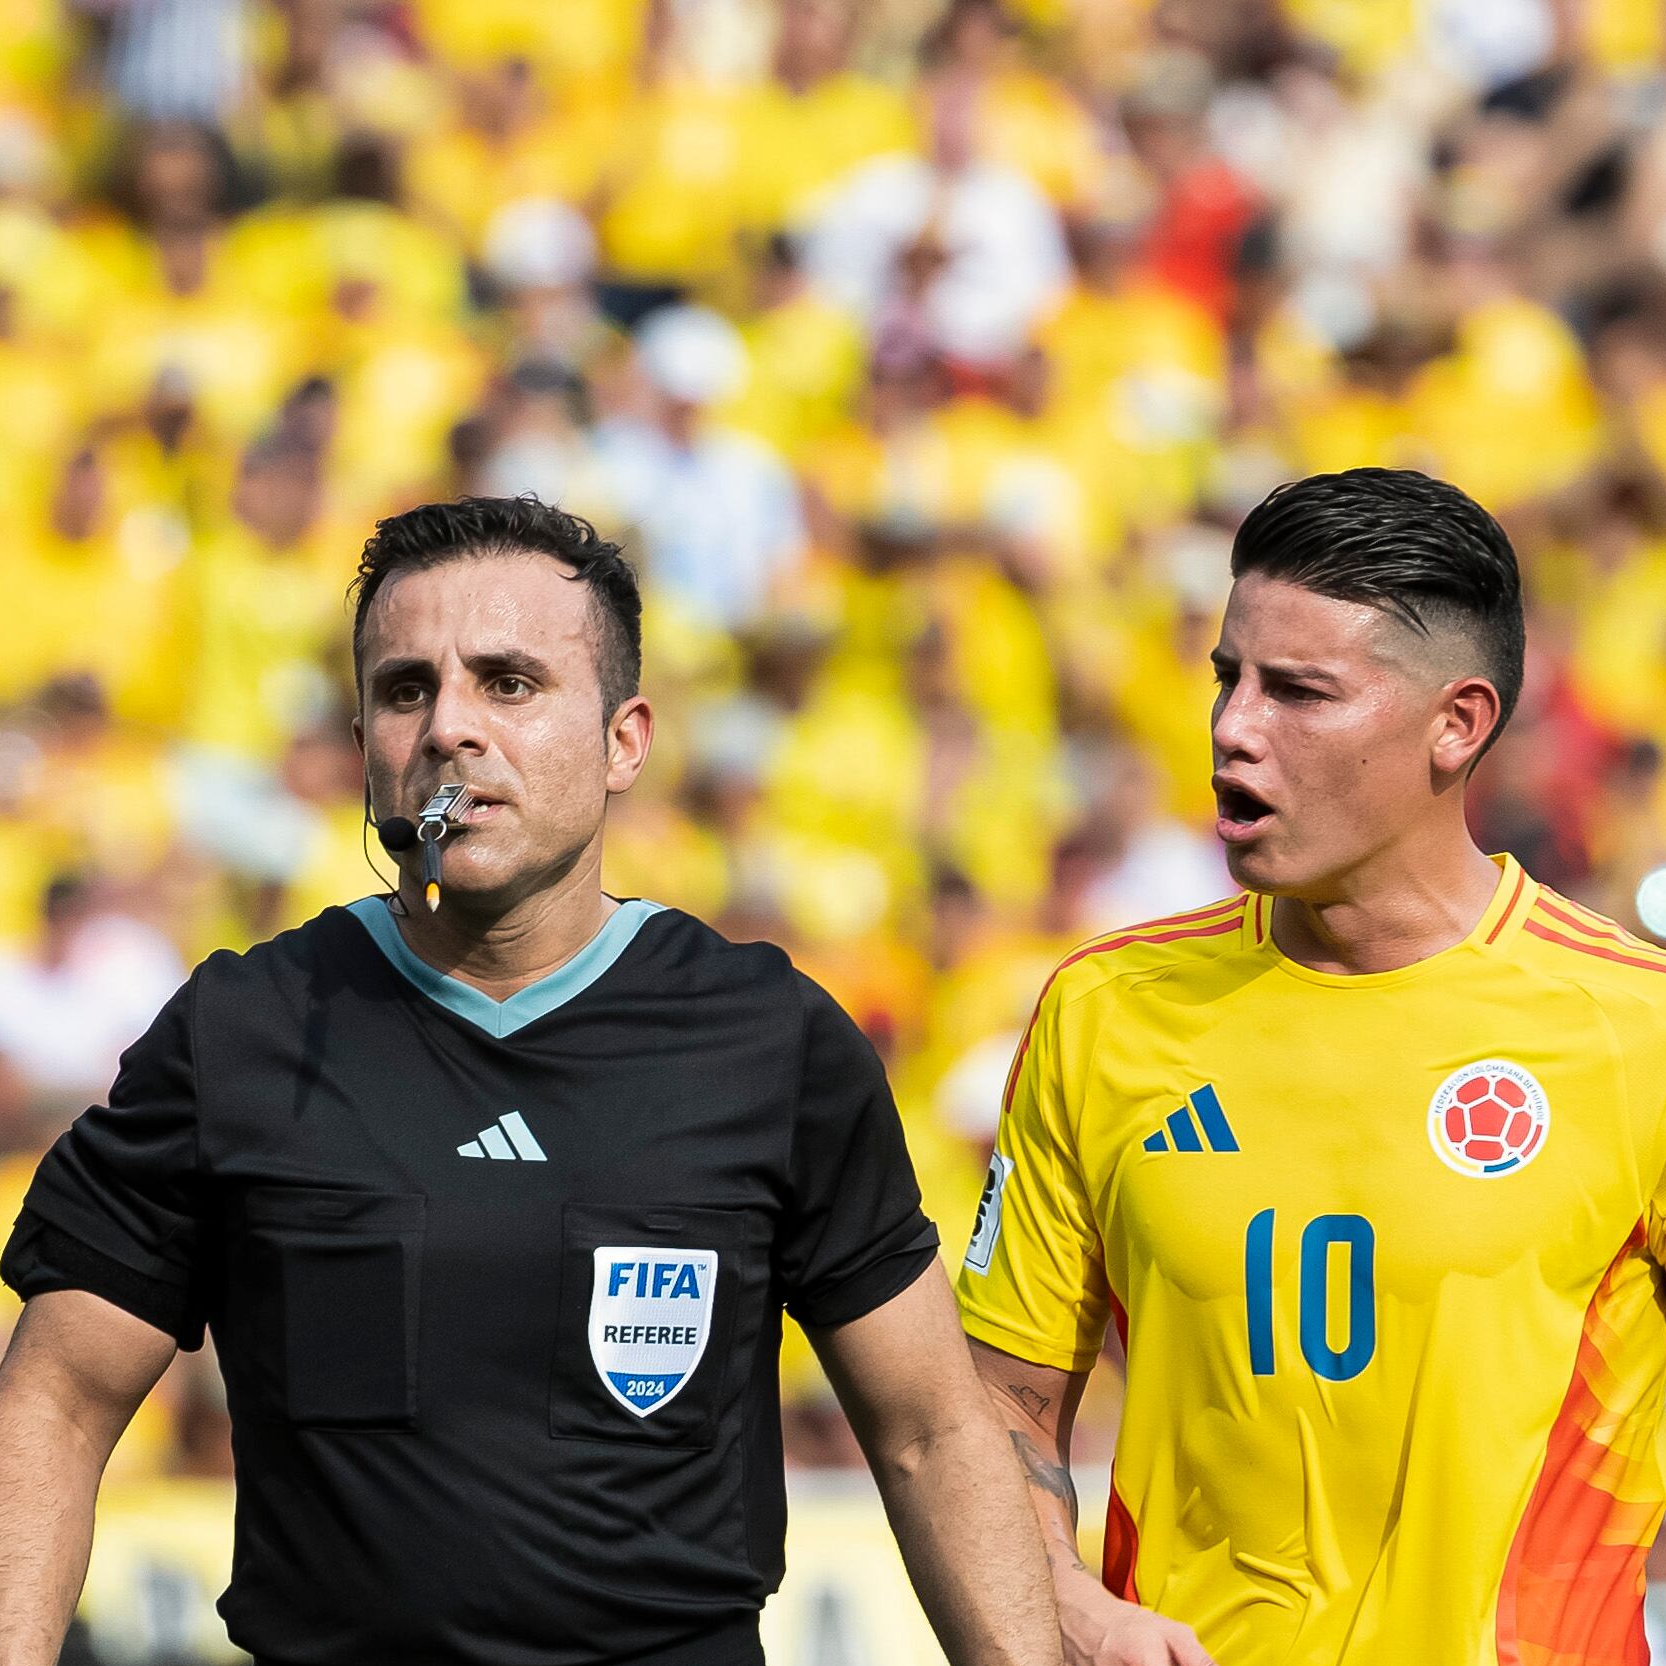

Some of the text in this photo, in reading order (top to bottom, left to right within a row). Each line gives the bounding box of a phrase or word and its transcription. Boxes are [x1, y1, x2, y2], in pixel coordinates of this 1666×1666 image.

[608, 1262, 700, 1299] FIFA
[1245, 1207, 1376, 1383] 10
[603, 1325, 697, 1345] REFEREE
[626, 1380, 665, 1397] 2024
